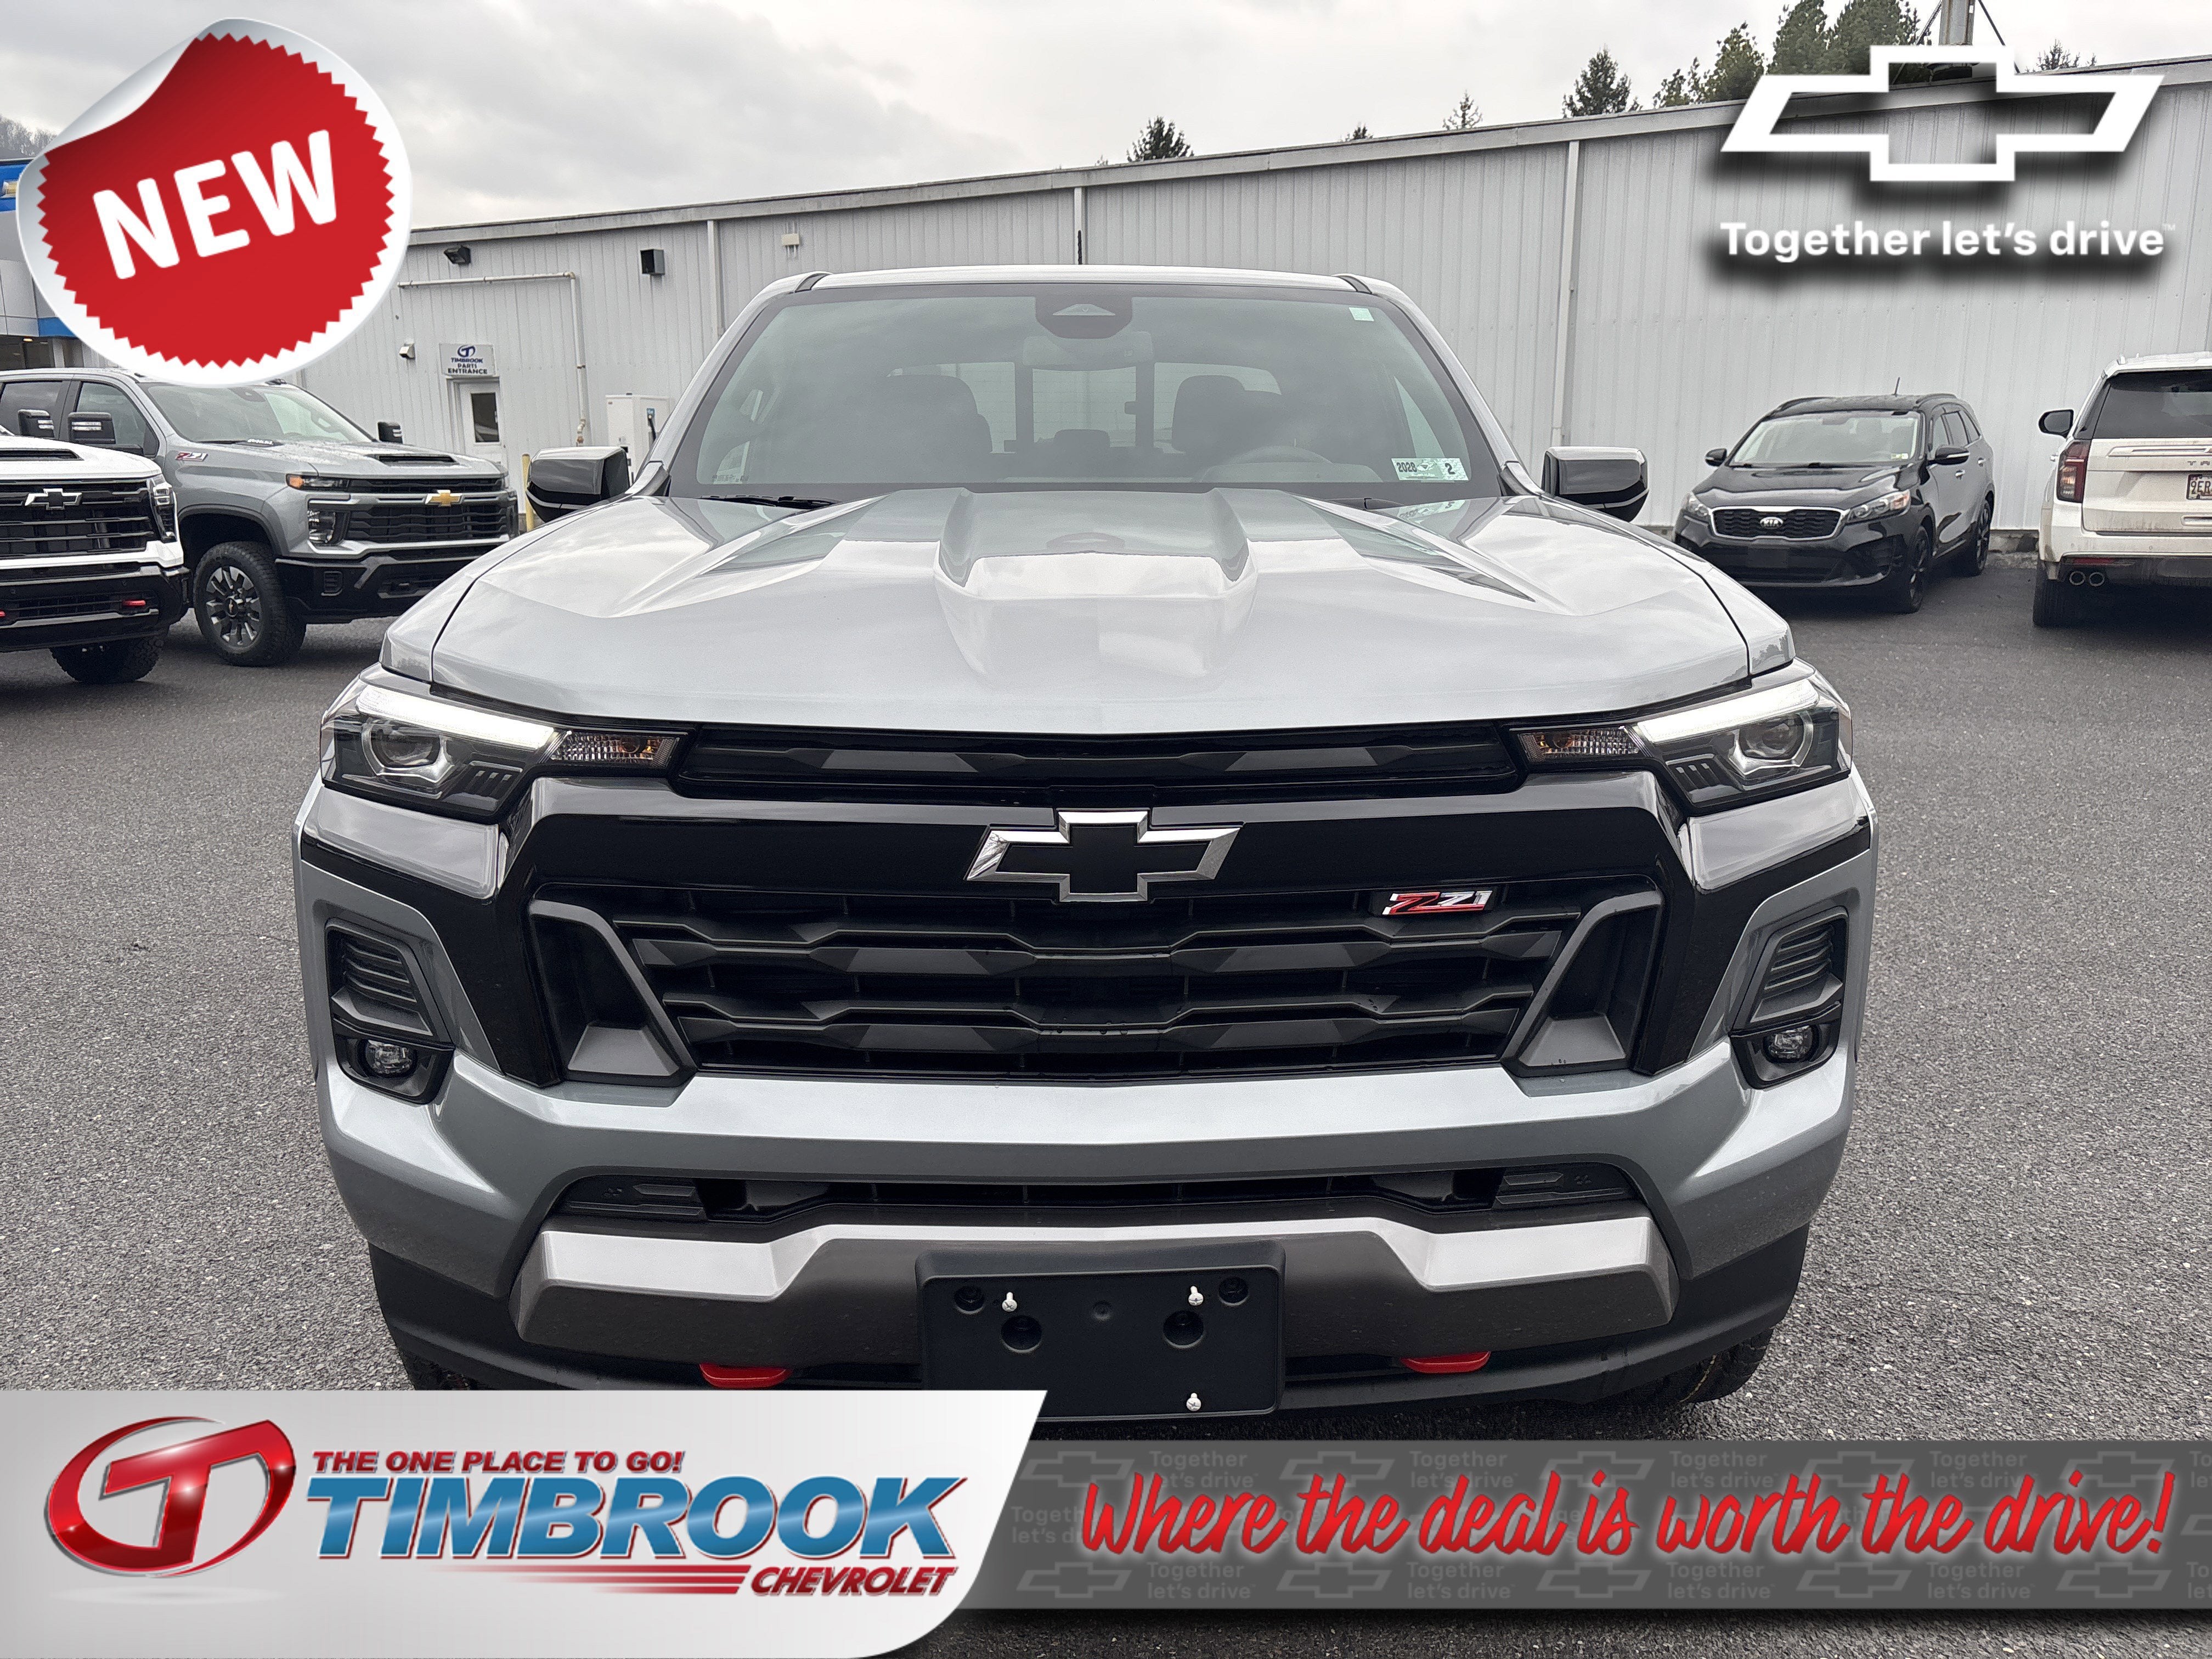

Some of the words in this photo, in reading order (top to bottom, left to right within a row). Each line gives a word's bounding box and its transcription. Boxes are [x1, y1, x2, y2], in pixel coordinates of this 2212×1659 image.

[1396, 462, 1418, 472] 2028
[1444, 463, 1455, 475] 2
[1382, 890, 1493, 915] Z71
